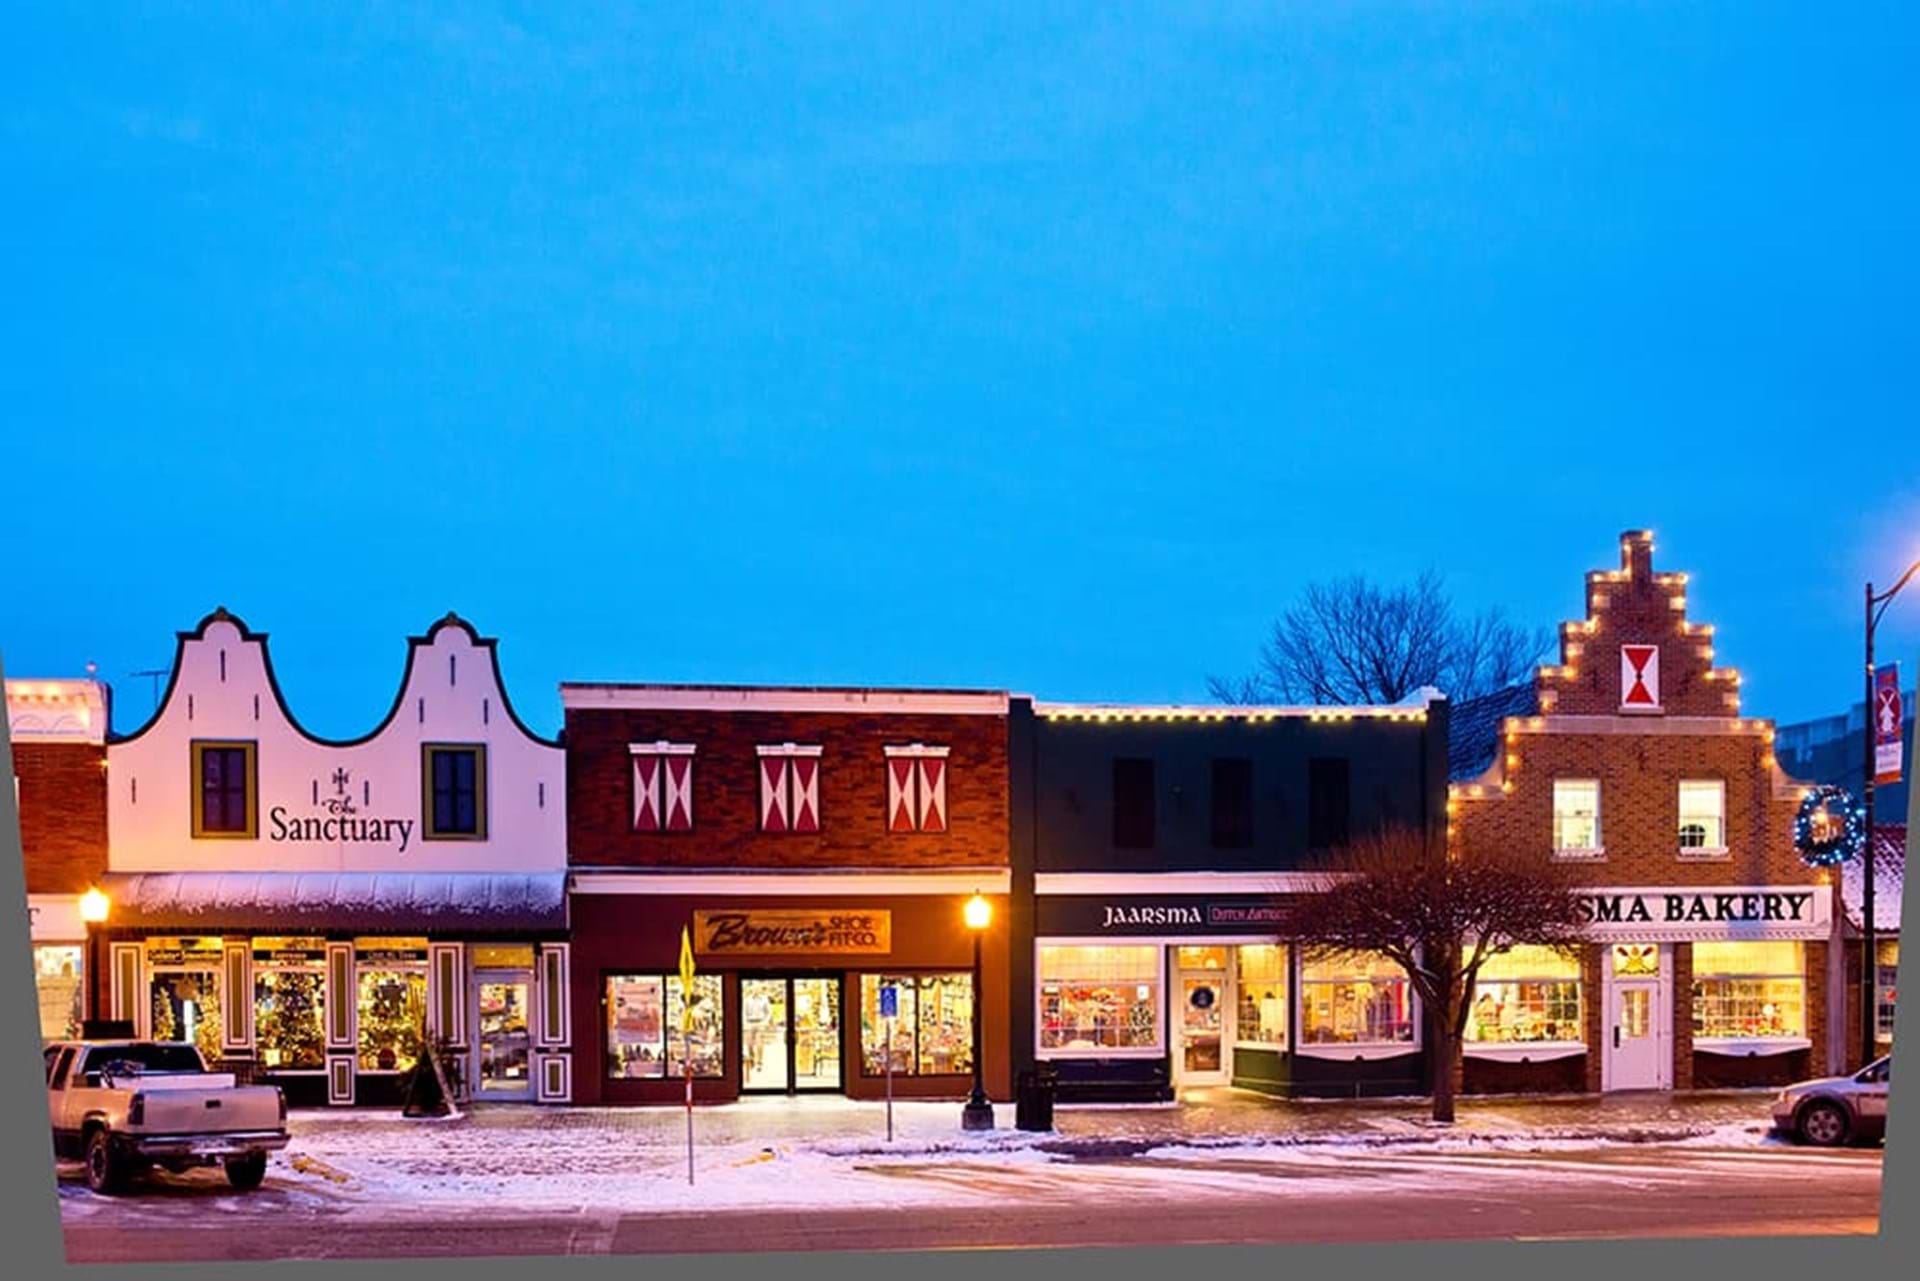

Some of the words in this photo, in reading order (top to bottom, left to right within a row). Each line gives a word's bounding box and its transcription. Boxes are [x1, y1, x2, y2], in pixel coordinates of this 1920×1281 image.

[269, 806, 415, 853] Sanctuary
[1103, 905, 1202, 928] JAARSMA
[1574, 894, 1653, 922] SMA
[1663, 894, 1813, 922] BAKERY
[829, 916, 873, 930] SHOE
